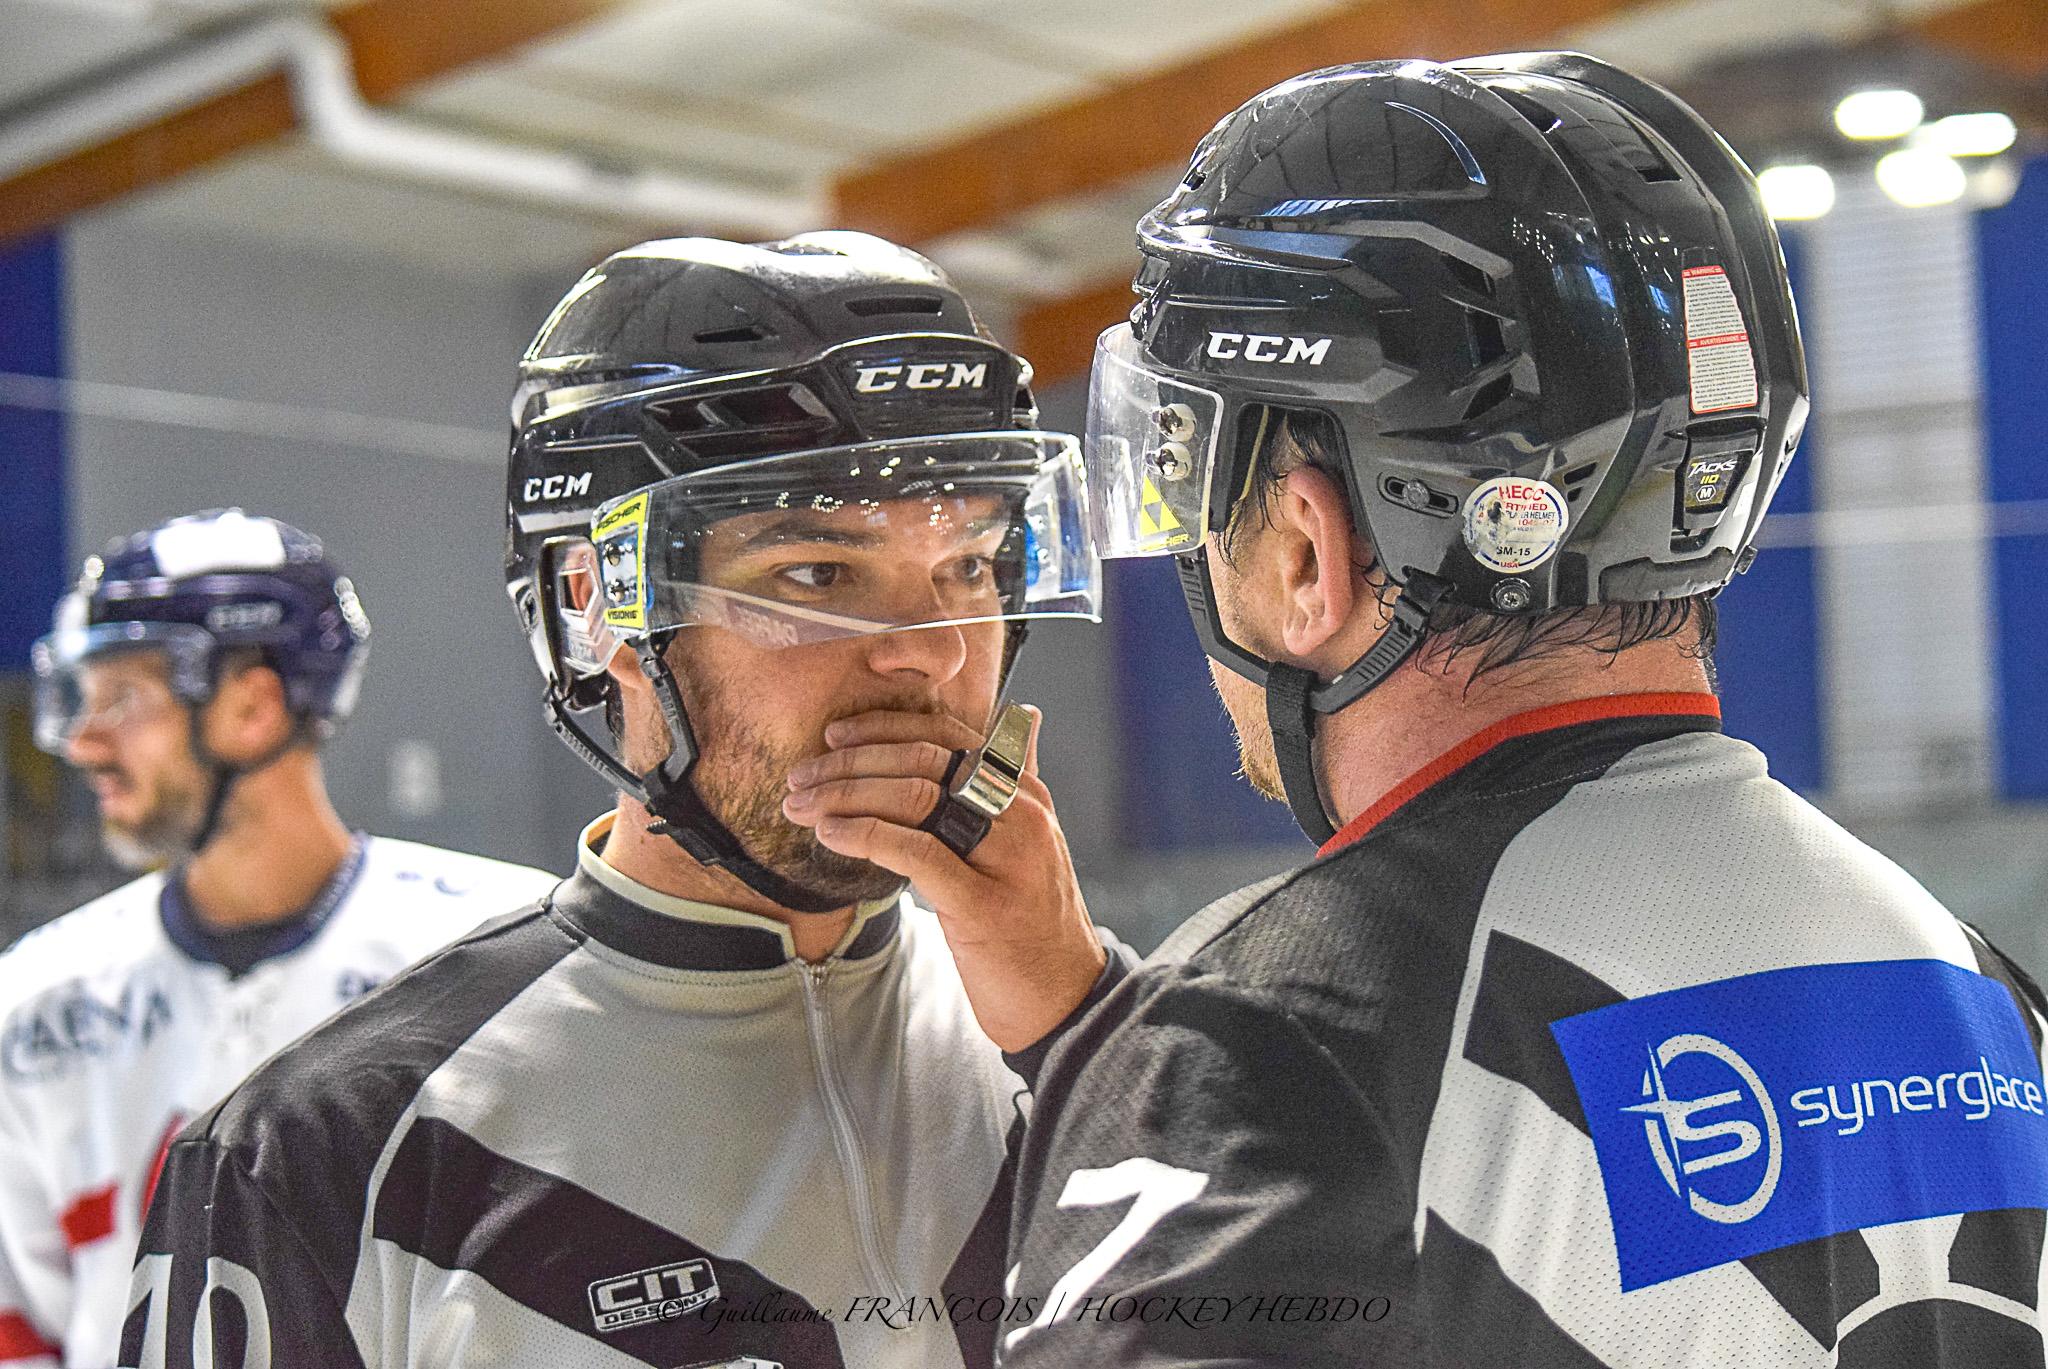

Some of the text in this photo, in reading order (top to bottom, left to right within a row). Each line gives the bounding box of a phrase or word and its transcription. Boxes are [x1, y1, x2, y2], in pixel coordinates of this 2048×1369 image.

[1207, 332, 1333, 365] CCM
[855, 363, 987, 393] CCM
[1688, 459, 1738, 478] TACKS
[1700, 474, 1720, 485] 110
[523, 471, 593, 502] CCM
[1498, 485, 1545, 501] HECC
[1496, 545, 1531, 556] SM-15
[1790, 1056, 2045, 1136] synerglace
[597, 1264, 704, 1311] CIT
